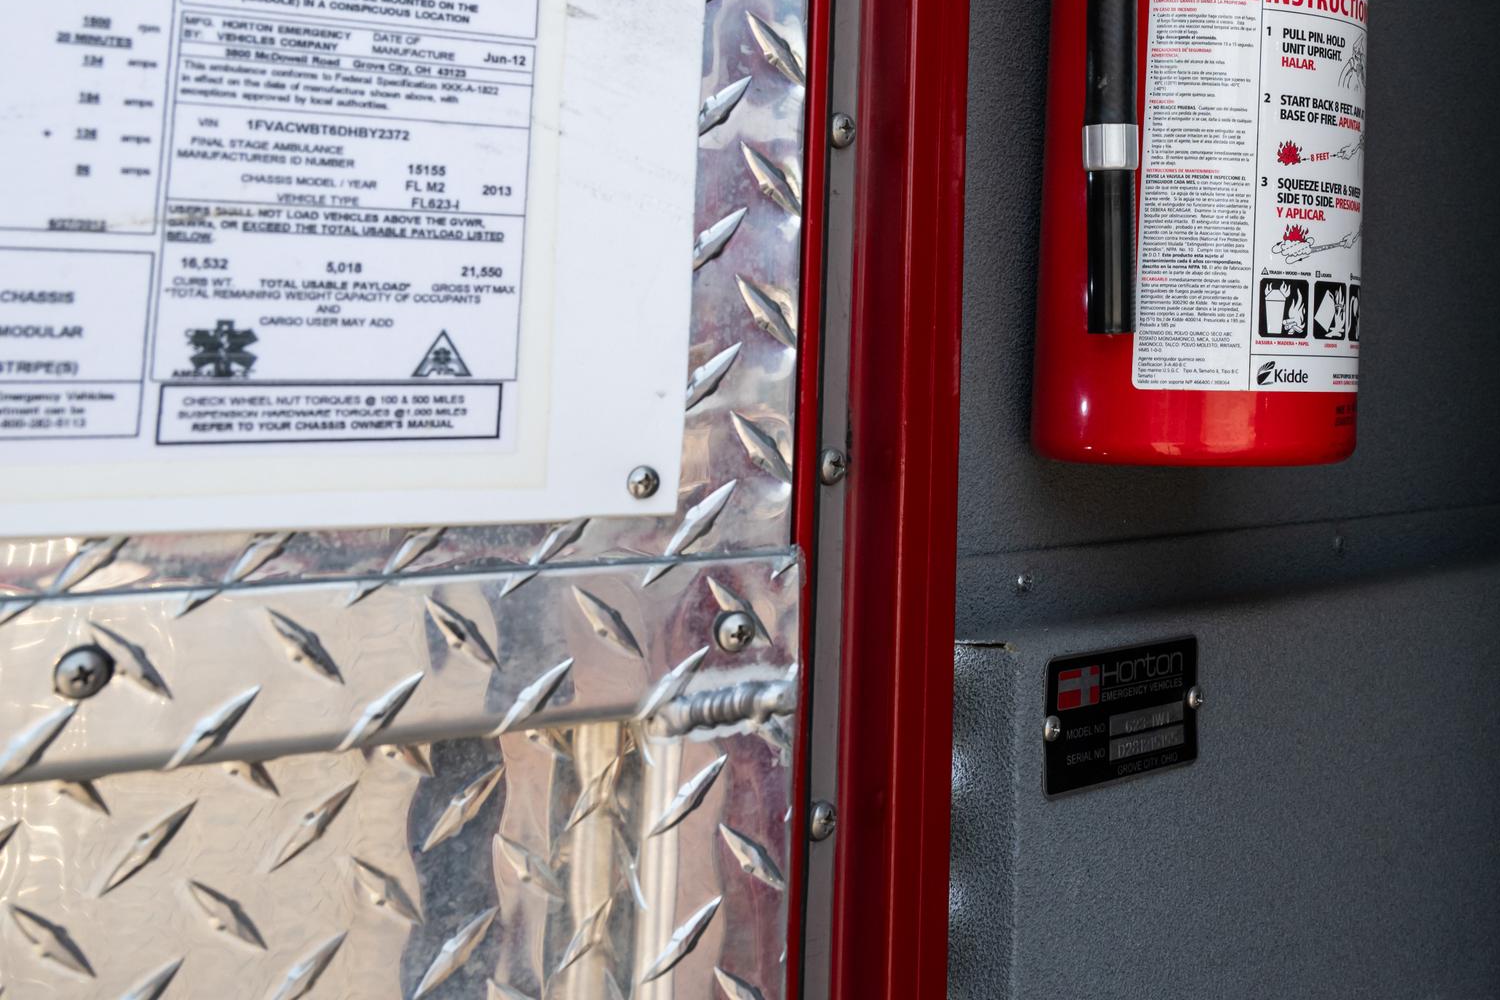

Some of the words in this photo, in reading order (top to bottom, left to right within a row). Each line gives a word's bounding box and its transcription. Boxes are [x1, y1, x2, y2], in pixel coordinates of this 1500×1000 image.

[328, 0, 411, 18] CONSPICUOUS
[414, 9, 470, 24] LOCATION
[1267, 26, 1272, 36] 1
[1282, 28, 1306, 42] PULL
[1307, 32, 1325, 45] PIN.
[1325, 35, 1346, 48] HOLD
[483, 52, 526, 67] Jun-12
[1282, 43, 1304, 56] UNIT
[1306, 46, 1342, 62] UPRIGHT.
[1281, 56, 1316, 71] HALAR.
[1264, 93, 1270, 103] 2
[1280, 95, 1310, 110] START
[1312, 99, 1334, 113] BACK
[1335, 101, 1340, 113] 8
[198, 118, 219, 128] VIN
[1280, 109, 1305, 124] BASE
[1307, 112, 1319, 125] OF
[1320, 113, 1338, 127] FIRE.
[1315, 152, 1329, 161] FEET
[408, 163, 446, 176] 15155
[1261, 177, 1268, 186] 3
[1277, 178, 1319, 193] SQUEEZE
[1320, 182, 1342, 195] LEVER
[1342, 184, 1348, 196] &
[405, 181, 421, 192] FL
[425, 182, 445, 194] M2
[482, 185, 512, 197] 2013
[1277, 192, 1299, 206] SIDE
[1302, 195, 1314, 208] TO
[1314, 196, 1334, 210] SIDE.
[1276, 207, 1282, 218] Y
[1285, 207, 1326, 222] APLICAR.
[181, 257, 228, 271] 16,532
[326, 262, 362, 274] 5,018
[460, 266, 503, 278] 21,550
[260, 279, 297, 289] TOTAL
[301, 280, 348, 290] USABLE
[431, 284, 470, 294] GROSS
[491, 284, 514, 294] MAX
[316, 305, 341, 314] AND
[259, 317, 303, 327] CARGO
[305, 317, 338, 327] USER
[340, 317, 365, 327] MAY
[369, 317, 394, 327] ADD
[1274, 369, 1309, 383] Kidde
[182, 396, 226, 406] CHECK
[228, 396, 272, 406] WHEEL
[275, 396, 301, 406] NUT
[304, 395, 361, 406] TORQUES
[364, 395, 376, 405] @
[380, 395, 398, 405] 100
[400, 395, 408, 405] &
[410, 395, 430, 405] 500
[432, 394, 464, 405] MILES
[191, 422, 234, 432] REFER
[237, 421, 254, 432] TO
[257, 421, 291, 431] YOUR
[294, 420, 346, 431] CHASSIS
[350, 420, 403, 430] OWNER'S
[406, 419, 453, 430] MANUAL
[1102, 652, 1183, 686] Horton
[1102, 686, 1148, 702] EMERGENCY
[1150, 677, 1183, 692] VEHICLES
[1067, 726, 1092, 740] MODEL
[1066, 752, 1092, 766] SERIAL
